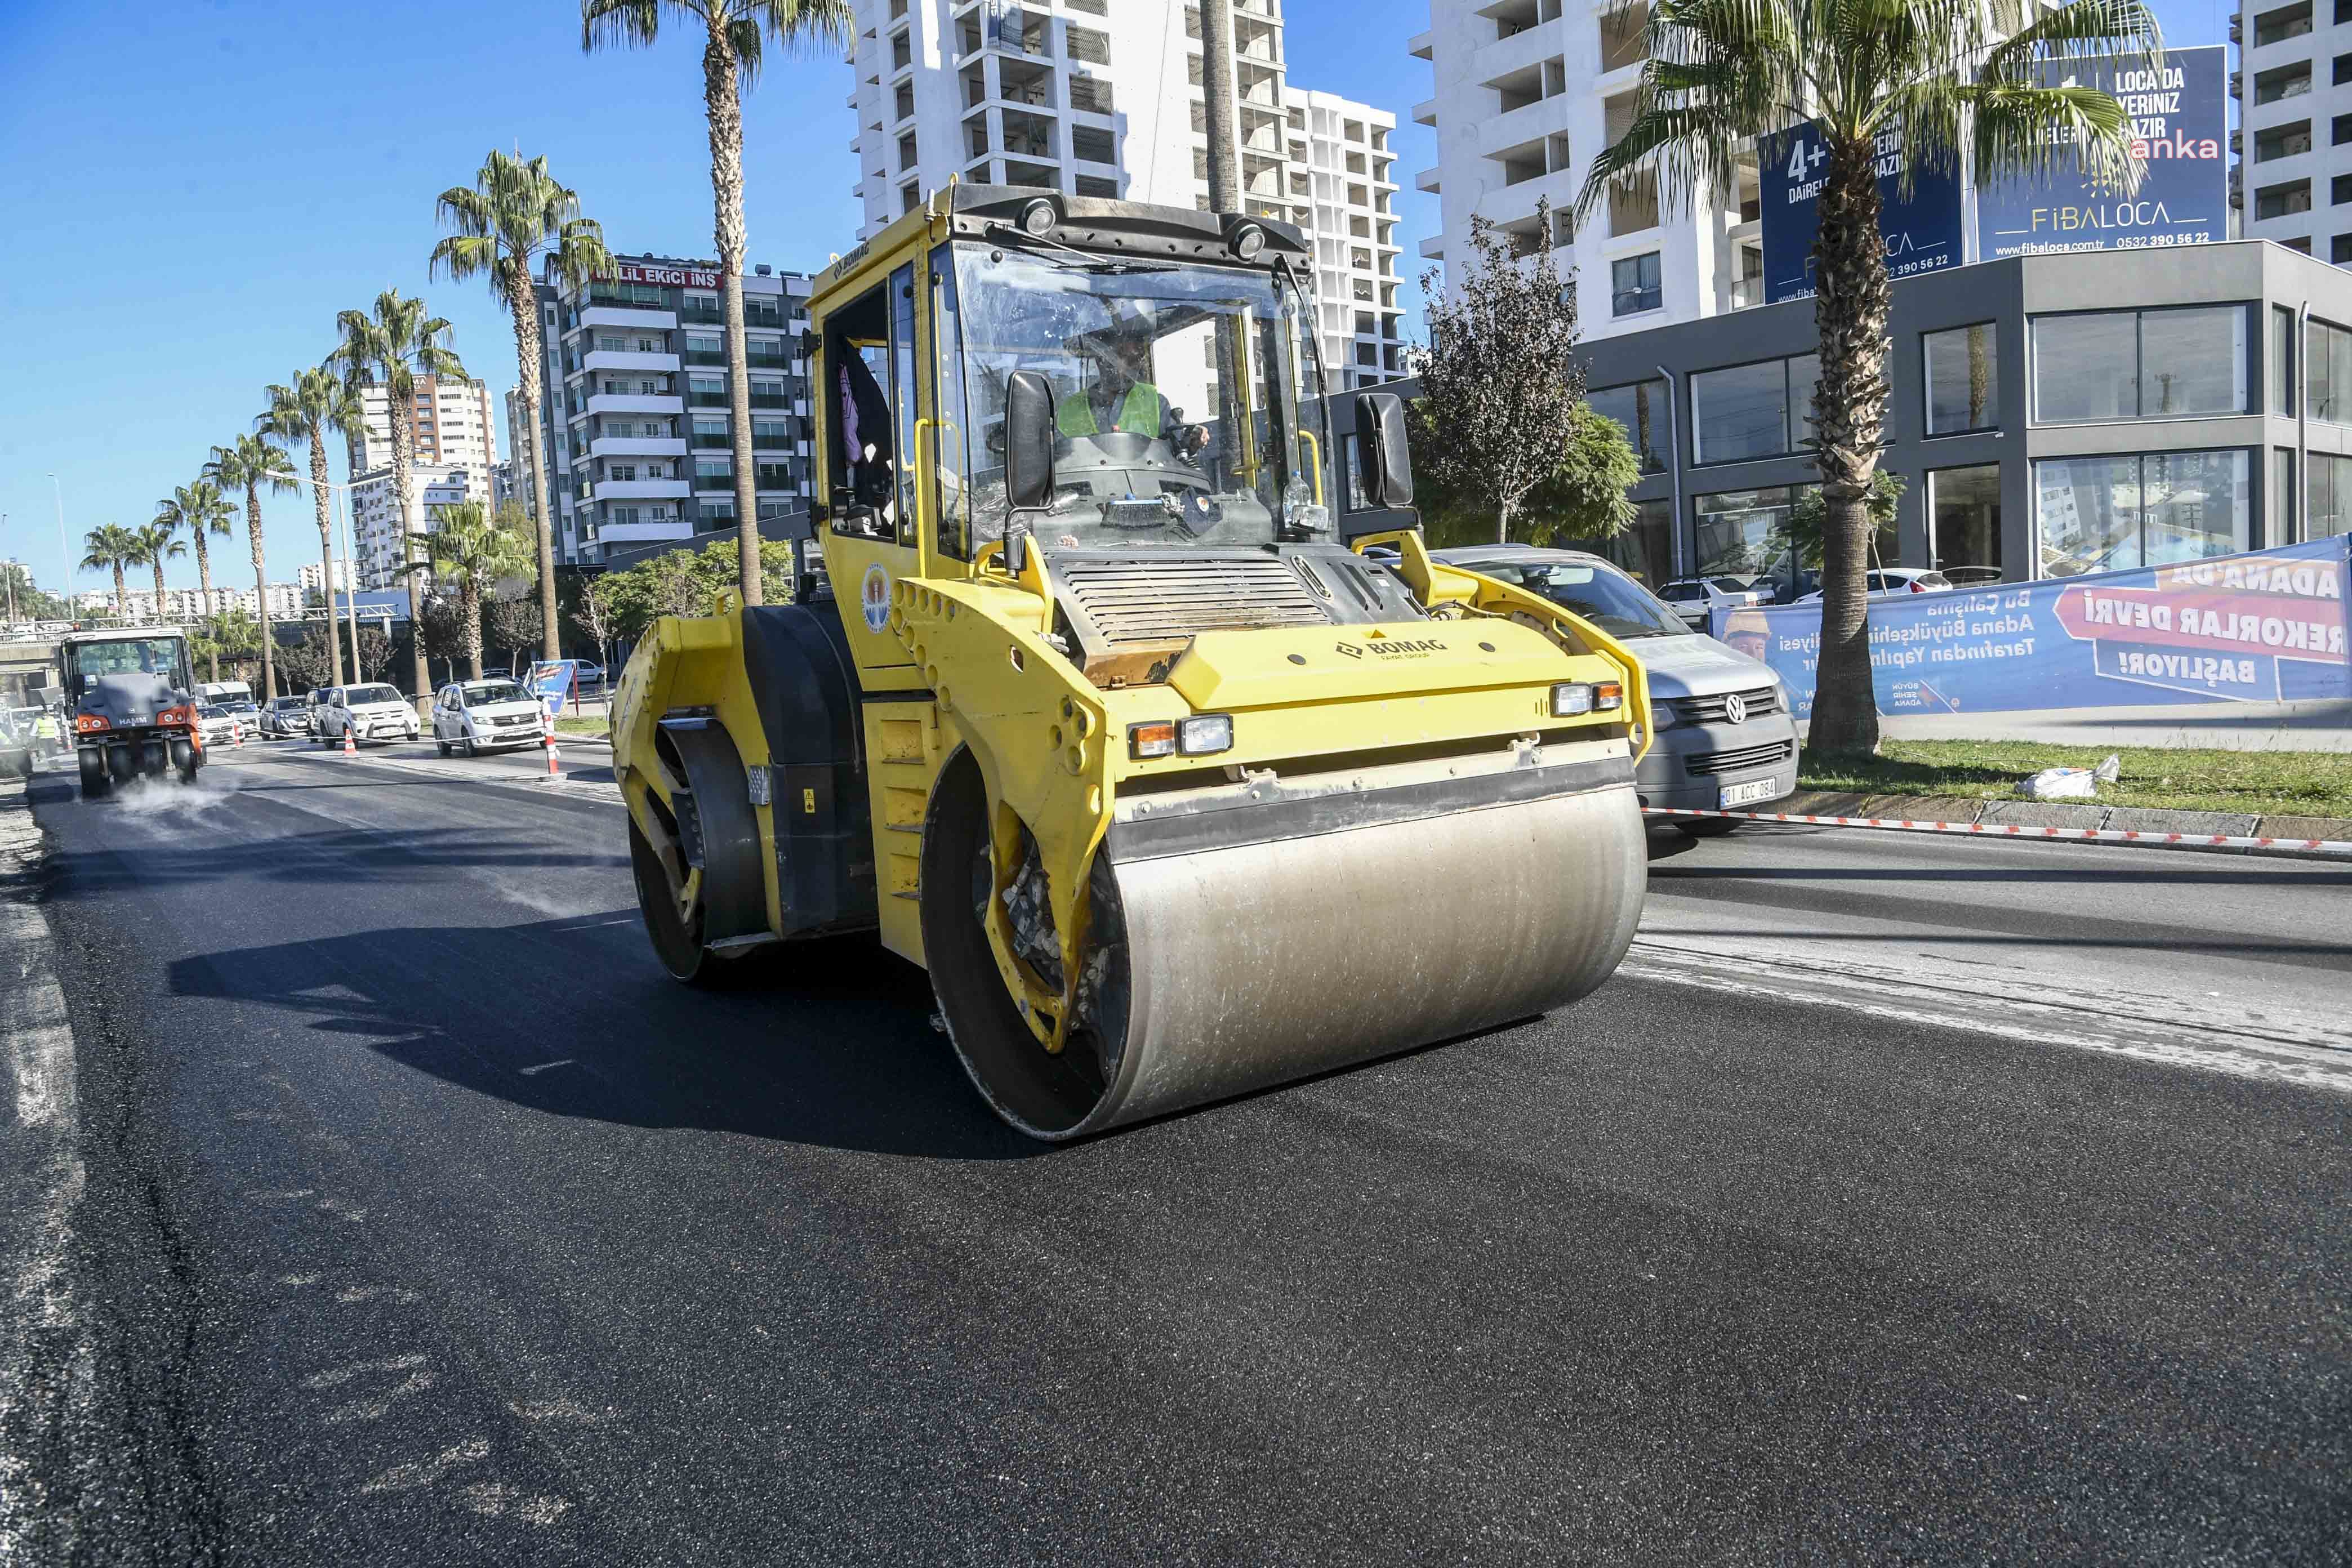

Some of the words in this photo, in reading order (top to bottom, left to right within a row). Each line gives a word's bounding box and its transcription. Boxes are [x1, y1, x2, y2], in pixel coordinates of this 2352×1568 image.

[1995, 240, 2105, 256] www.fibaloca.com.tr
[2117, 237, 2147, 248] 0532
[2150, 234, 2173, 246] 390
[2177, 233, 2192, 244] 56
[2195, 231, 2210, 243] 22
[1897, 262, 1917, 275] 390
[1921, 257, 1933, 270] 56
[1936, 254, 1948, 266] 22
[1365, 639, 1448, 654] BOMAG
[119, 716, 147, 725] HAMM
[1726, 789, 1735, 803] 01
